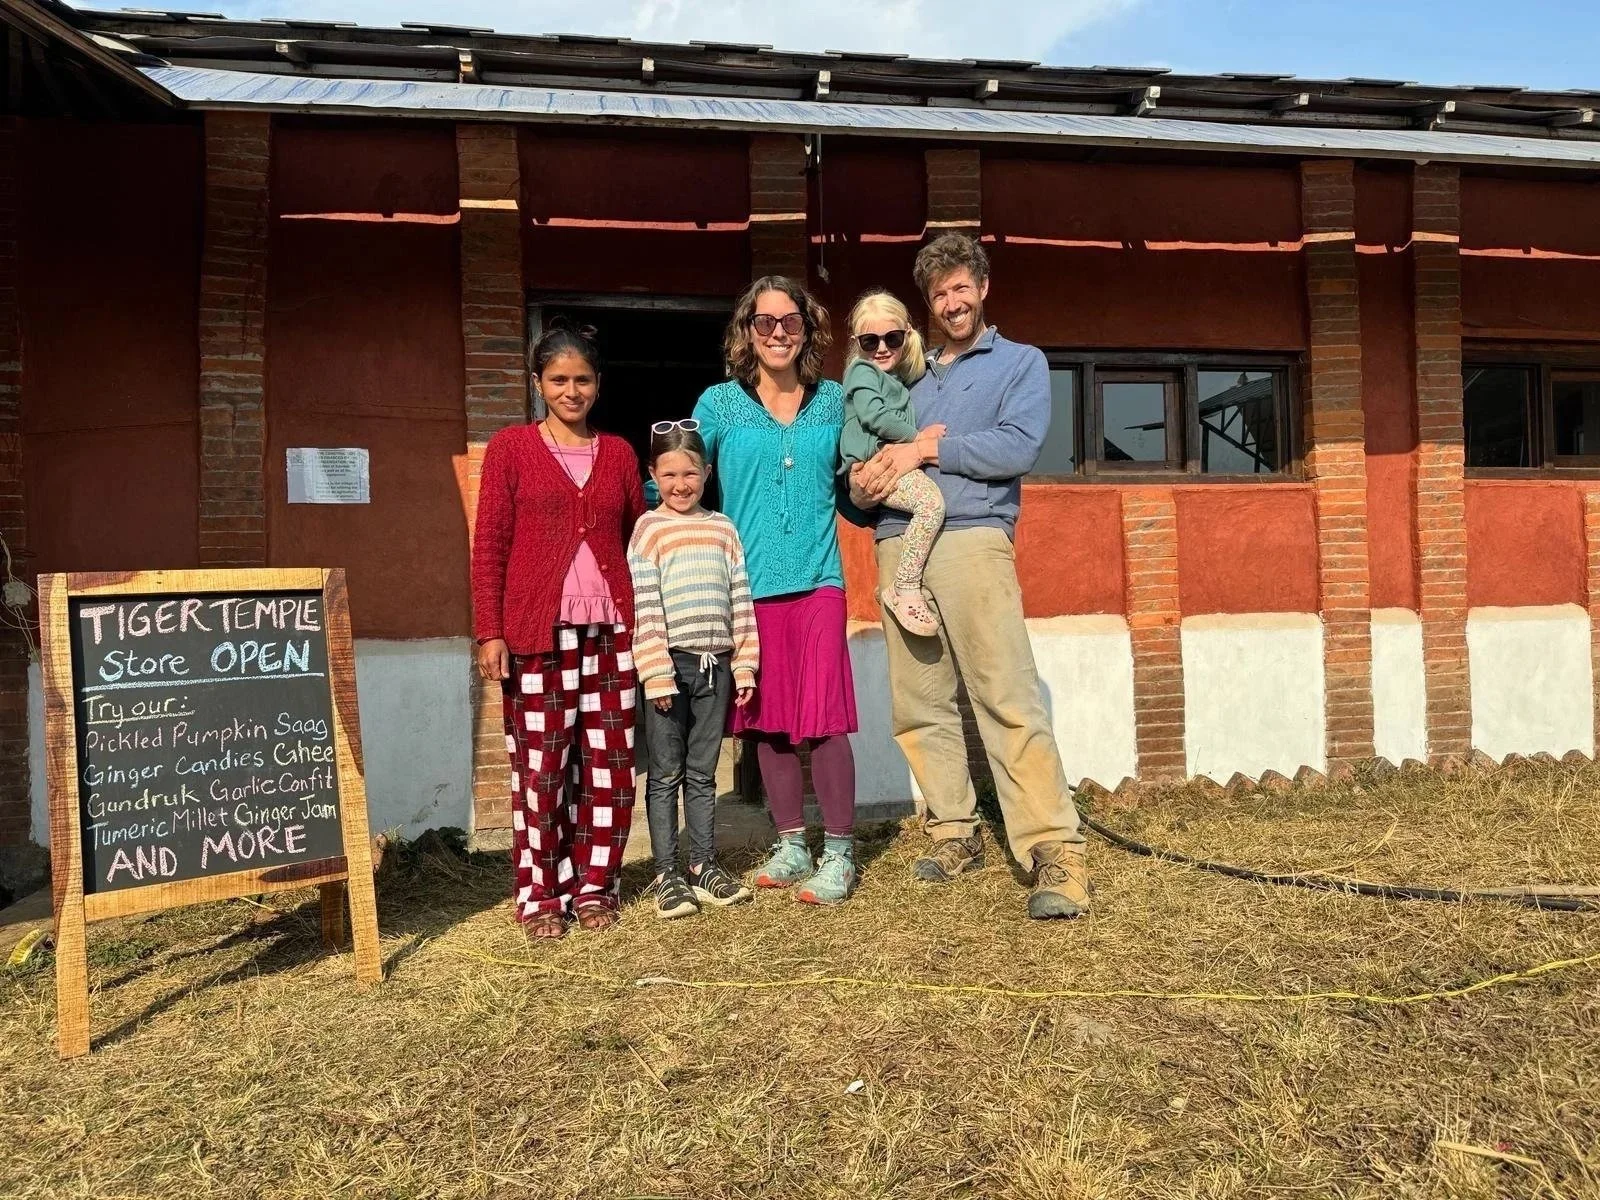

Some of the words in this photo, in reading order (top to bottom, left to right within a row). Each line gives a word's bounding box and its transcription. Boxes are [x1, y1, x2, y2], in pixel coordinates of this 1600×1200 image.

[80, 599, 213, 644] TIGER
[209, 598, 321, 631] TEMPLE
[99, 650, 189, 681] Store
[211, 640, 309, 673] OPEN
[82, 695, 123, 728] Try
[132, 696, 187, 715] our:
[85, 728, 162, 758] Pickled
[173, 718, 267, 752] Pumpkin
[274, 712, 328, 740] Saag
[83, 765, 163, 788] Ginger
[176, 749, 264, 775] Candies
[274, 741, 333, 765] Ghee
[210, 778, 275, 802] Garlic
[278, 767, 333, 791] Confit
[87, 819, 168, 850] Tumeric
[172, 807, 227, 833] Millet
[234, 802, 297, 832] Ginger
[299, 796, 336, 819] Jam
[106, 845, 177, 883] AND
[201, 824, 307, 869] MORE
